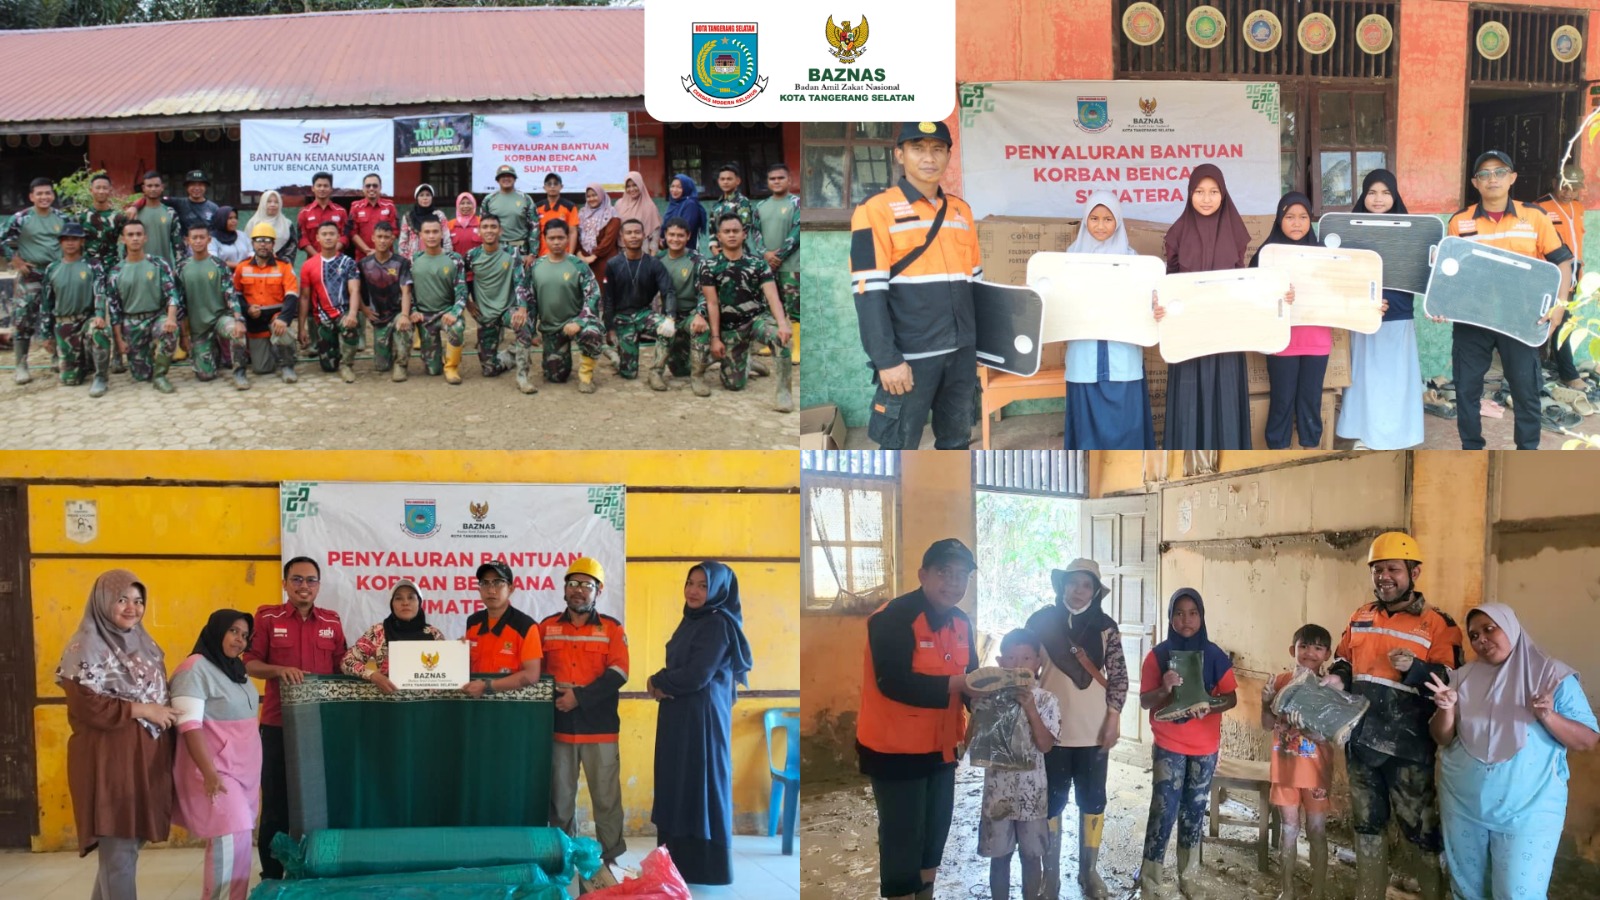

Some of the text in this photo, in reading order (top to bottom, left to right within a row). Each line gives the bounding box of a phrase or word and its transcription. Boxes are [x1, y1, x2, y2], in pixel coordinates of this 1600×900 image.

[413, 127, 455, 140] TNI AD
[410, 145, 462, 154] UNTUK RAKYAT
[491, 142, 610, 151] PENYALURAN BANTUAN
[1005, 144, 1243, 160] PENYALURAN BANTUAN
[249, 152, 385, 162] BANTUAN KEMANUSIAAN
[504, 154, 597, 162] KORBAN BENCANA
[253, 163, 380, 171] UNTUK BENCANA SUMATERA
[523, 165, 578, 173] SUMATERA
[1033, 166, 1198, 182] KORBAN BENCA
[1075, 188, 1184, 204] SATERA
[327, 551, 474, 567] PENYALURAN
[454, 576, 555, 591] BEANA
